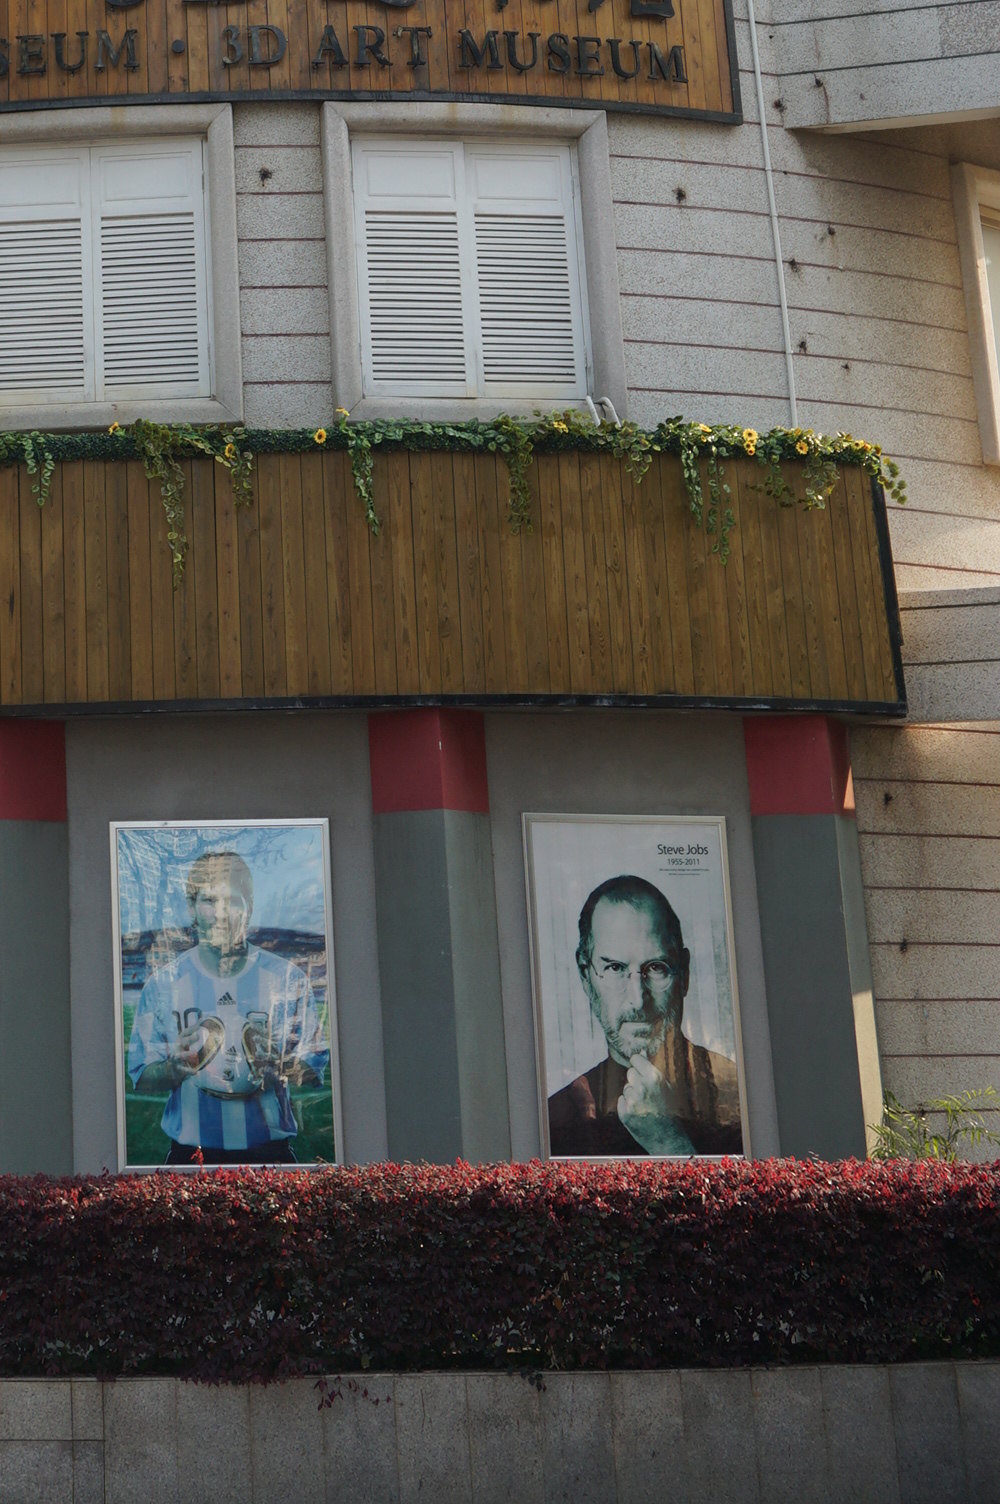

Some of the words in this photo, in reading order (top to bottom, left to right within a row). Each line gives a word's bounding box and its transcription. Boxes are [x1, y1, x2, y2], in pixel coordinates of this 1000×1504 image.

[221, 24, 289, 69] 3D
[311, 24, 433, 71] ART
[458, 28, 689, 84] MUSEUM
[657, 843, 685, 855] Steve
[687, 843, 709, 856] Jobs
[668, 858, 700, 866] 1955-2011
